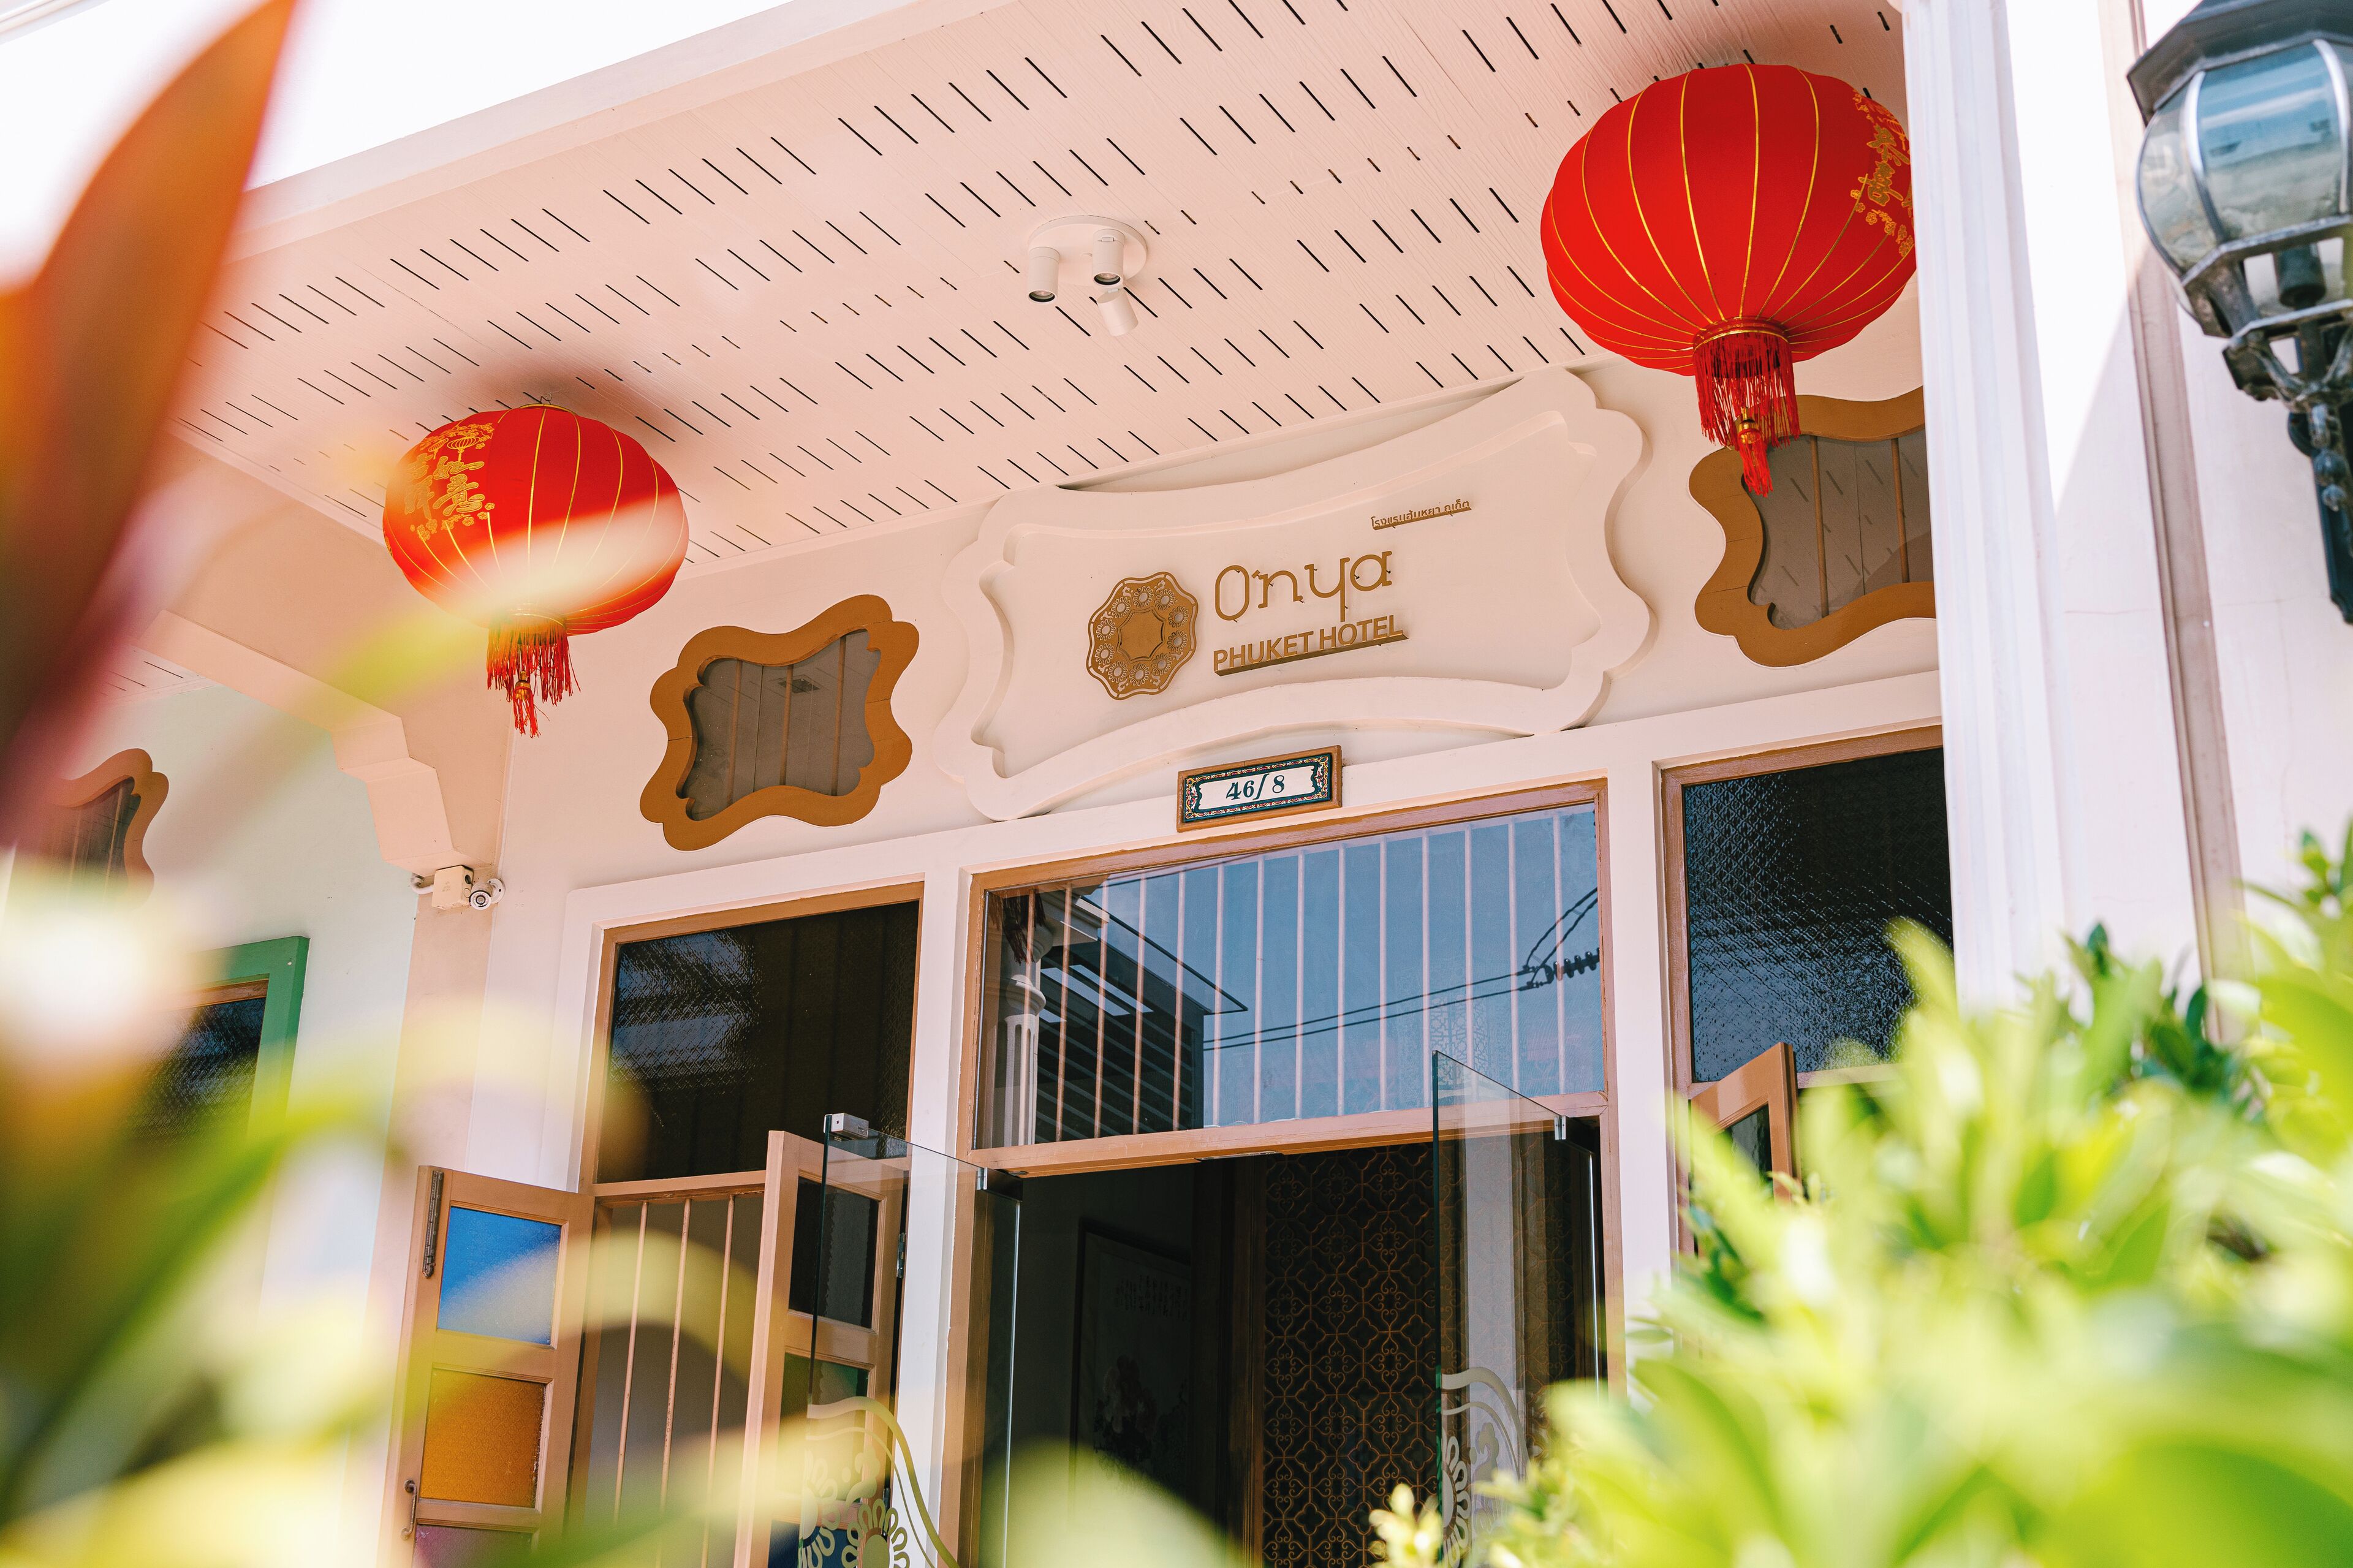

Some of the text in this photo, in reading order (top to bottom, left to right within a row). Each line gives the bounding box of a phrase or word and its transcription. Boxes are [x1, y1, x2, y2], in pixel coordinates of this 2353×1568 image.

[1444, 498, 1470, 513] ภเก็ต
[1213, 615, 1403, 672] PHUKET HOTEL
[1226, 773, 1285, 800] 46/8
